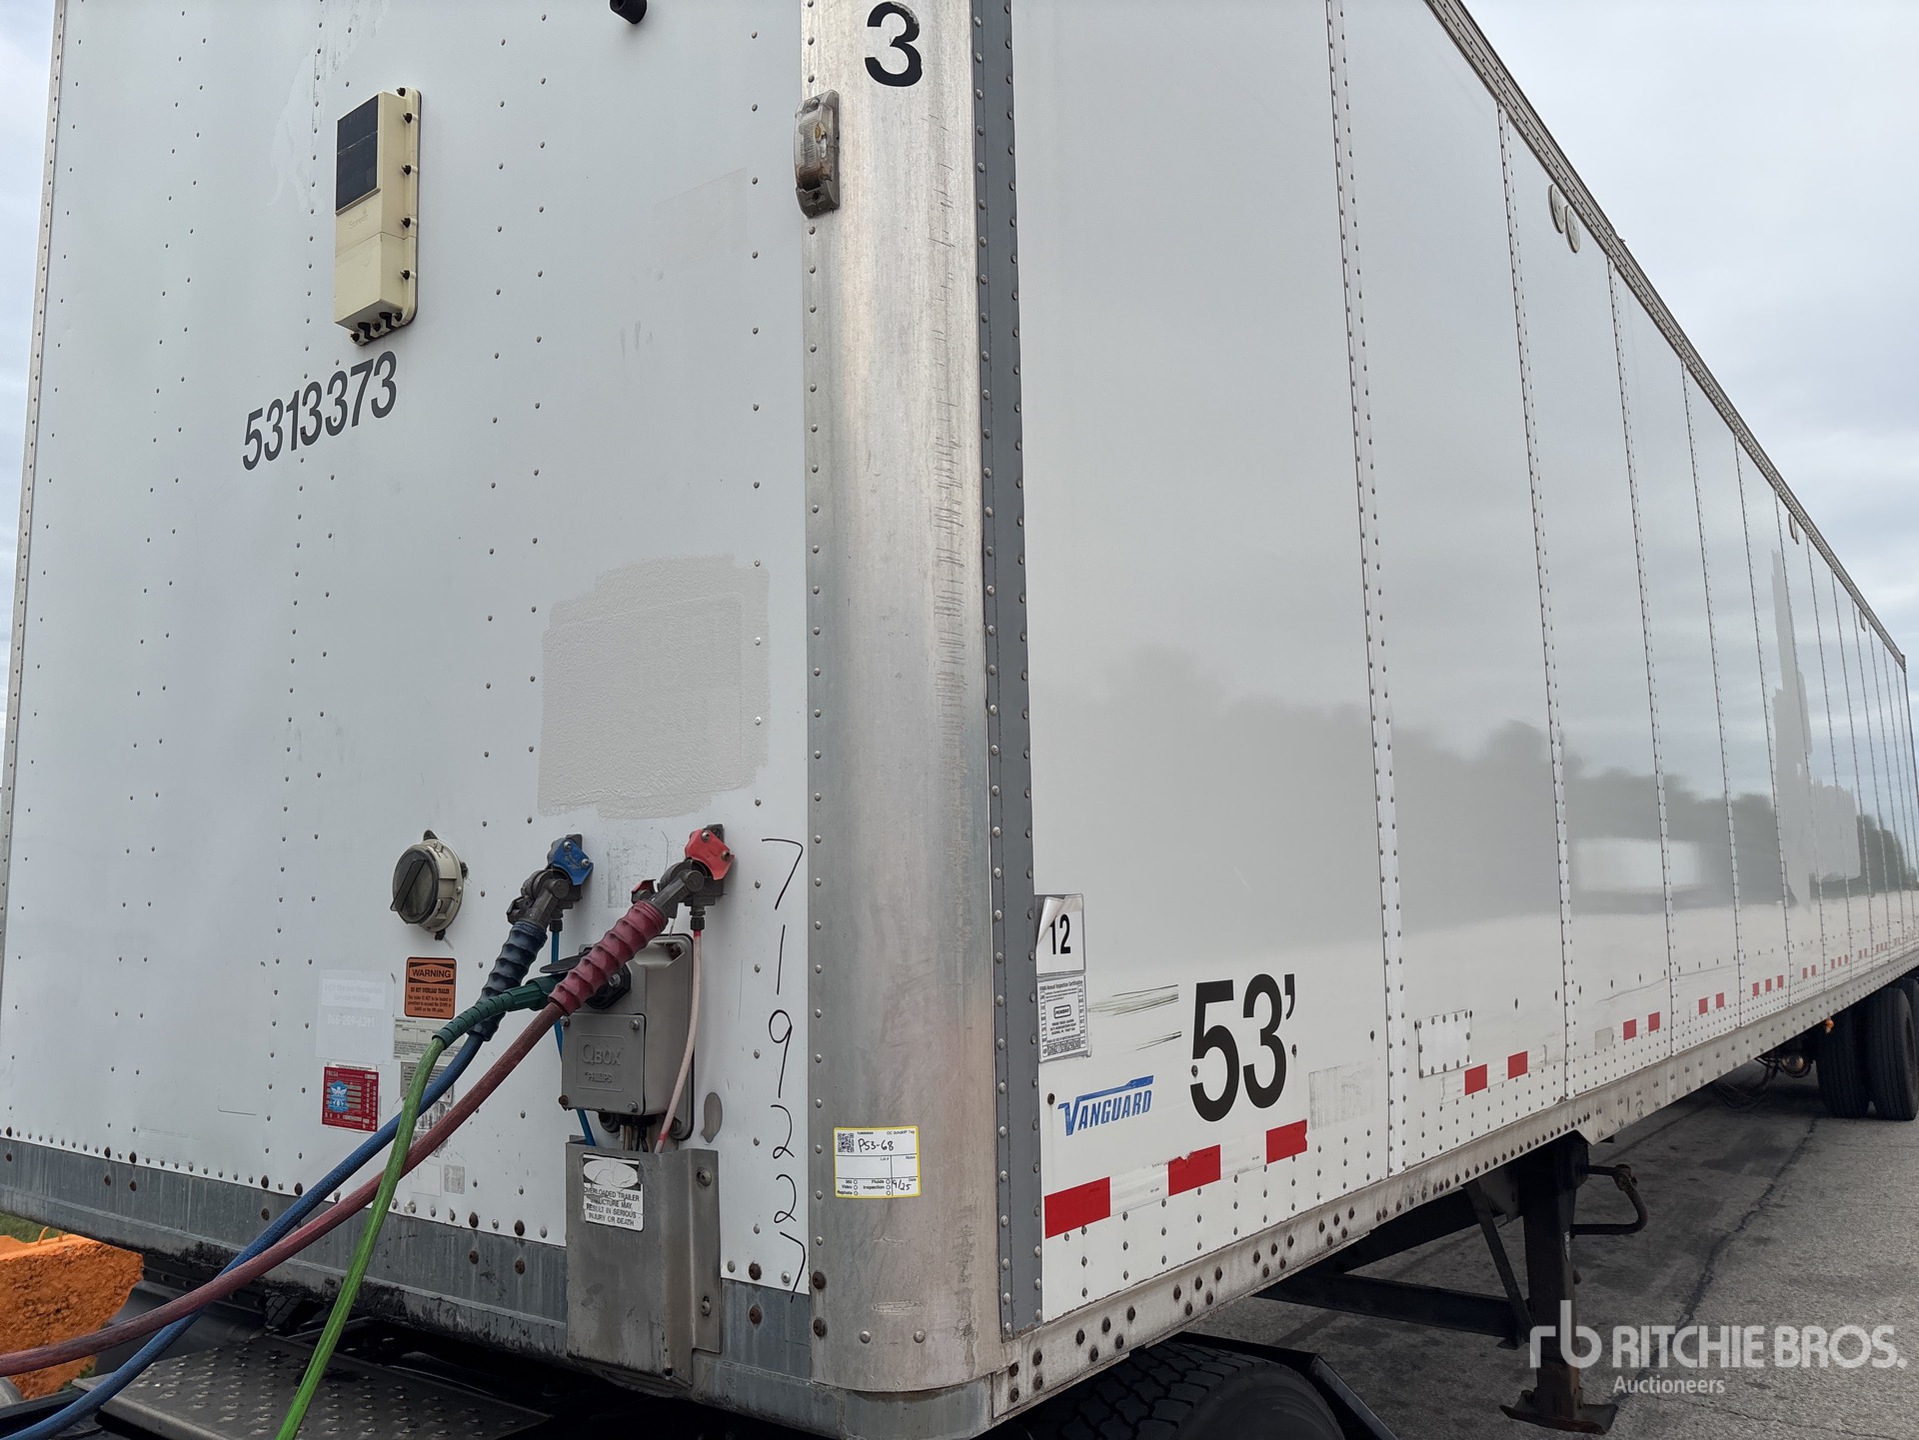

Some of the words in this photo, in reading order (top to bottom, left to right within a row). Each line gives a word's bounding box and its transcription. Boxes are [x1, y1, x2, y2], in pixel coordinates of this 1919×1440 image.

[865, 2, 923, 88] 3
[242, 350, 397, 471] 5313373
[1049, 913, 1071, 955] 12
[412, 969, 451, 978] WARNING
[1058, 1074, 1154, 1136] VANGUARD
[617, 1191, 640, 1202] TRAILER
[586, 1203, 604, 1213] RESULT
[613, 1208, 637, 1219] SERIOUS
[621, 1201, 632, 1209] MAY
[589, 1213, 606, 1222] INJURY
[608, 1215, 615, 1223] OR
[616, 1216, 635, 1227] DEATH
